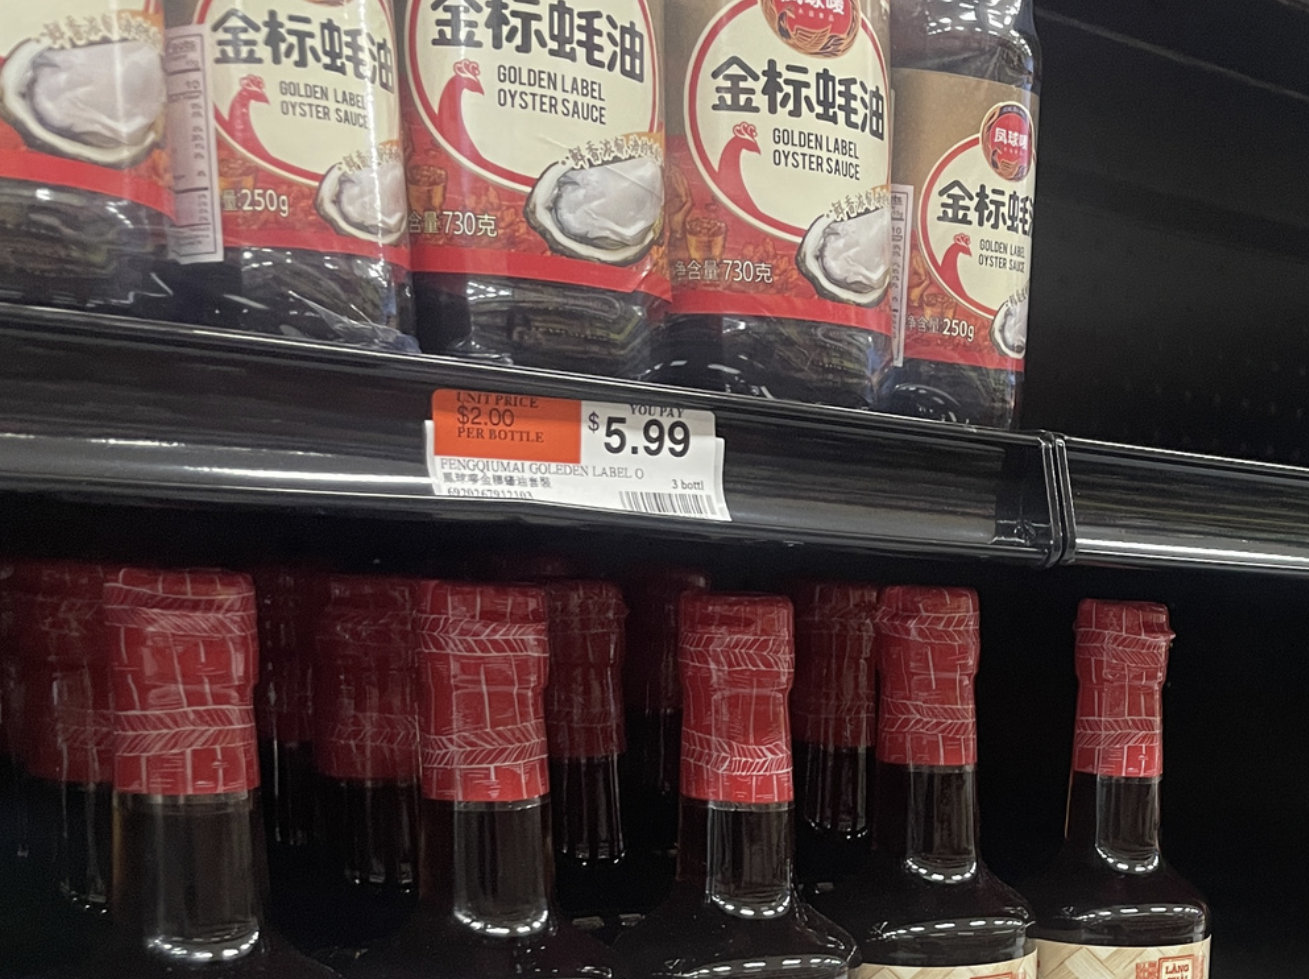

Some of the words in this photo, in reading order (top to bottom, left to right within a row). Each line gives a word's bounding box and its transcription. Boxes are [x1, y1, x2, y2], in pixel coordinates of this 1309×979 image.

[211, 8, 396, 93] 金标蚝油
[431, 0, 644, 83] 金标蚝油
[280, 81, 329, 103] GOLDEN
[334, 89, 367, 110] LABEL
[498, 65, 557, 92] GOLDEN
[561, 72, 605, 101] LABEL
[498, 88, 558, 116] OYSTER
[562, 98, 606, 125] SAUCE
[711, 56, 884, 140] 金标蚝油
[280, 101, 330, 121] OYSTER
[773, 128, 822, 152] GOLDEN
[826, 135, 859, 159] LABEL
[773, 150, 823, 174] OYSTER
[826, 156, 860, 181] SAUCE
[979, 238, 1008, 254] GOLDEN
[978, 254, 1007, 269] OYSTER
[494, 394, 539, 409] PRICE
[630, 403, 657, 417] YOU
[660, 405, 684, 418] PAY
[457, 403, 514, 428] $2.00
[457, 427, 485, 440] PER
[489, 428, 544, 444] BOTTLE
[529, 463, 589, 477] GOLEDEN
[592, 465, 632, 479] LABEL
[671, 479, 678, 490] 3
[680, 479, 705, 491] bottl
